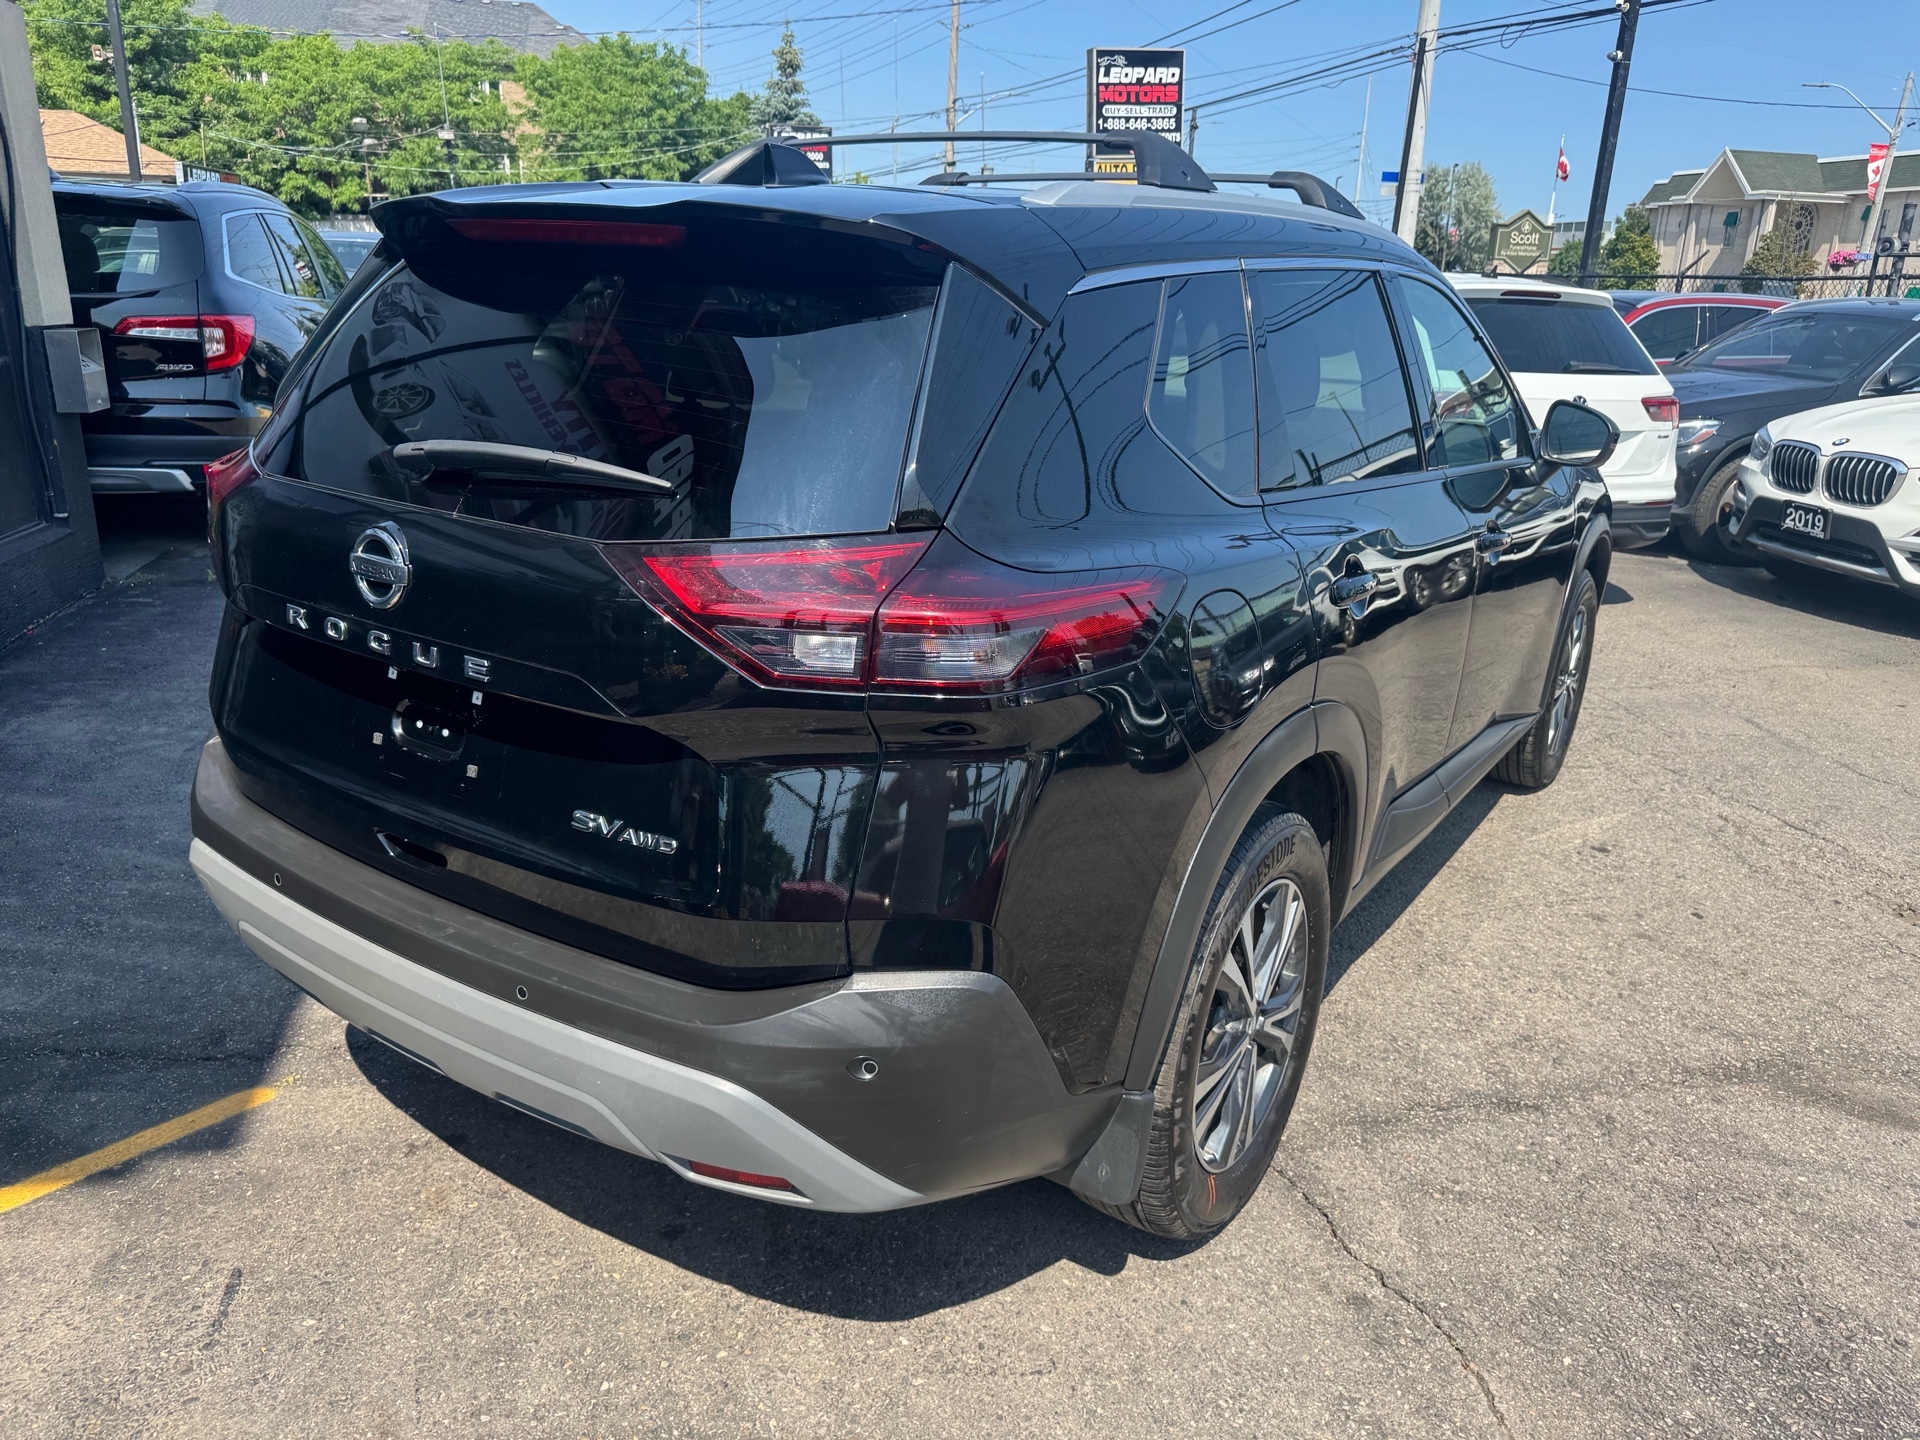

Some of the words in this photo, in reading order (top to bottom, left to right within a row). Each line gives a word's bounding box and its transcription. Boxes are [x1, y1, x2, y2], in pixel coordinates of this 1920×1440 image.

[1098, 67, 1180, 83] LEOPARD
[1099, 85, 1178, 102] MOTORS
[1104, 107, 1174, 115] BUY-SELL-TRADE
[1098, 118, 1176, 130] 1-888-646-3865
[1510, 231, 1539, 244] Scott
[155, 363, 194, 371] AWD
[1785, 507, 1824, 531] 2019
[286, 603, 492, 683] ROGUE
[571, 809, 623, 839] SV
[617, 827, 679, 855] AWD
